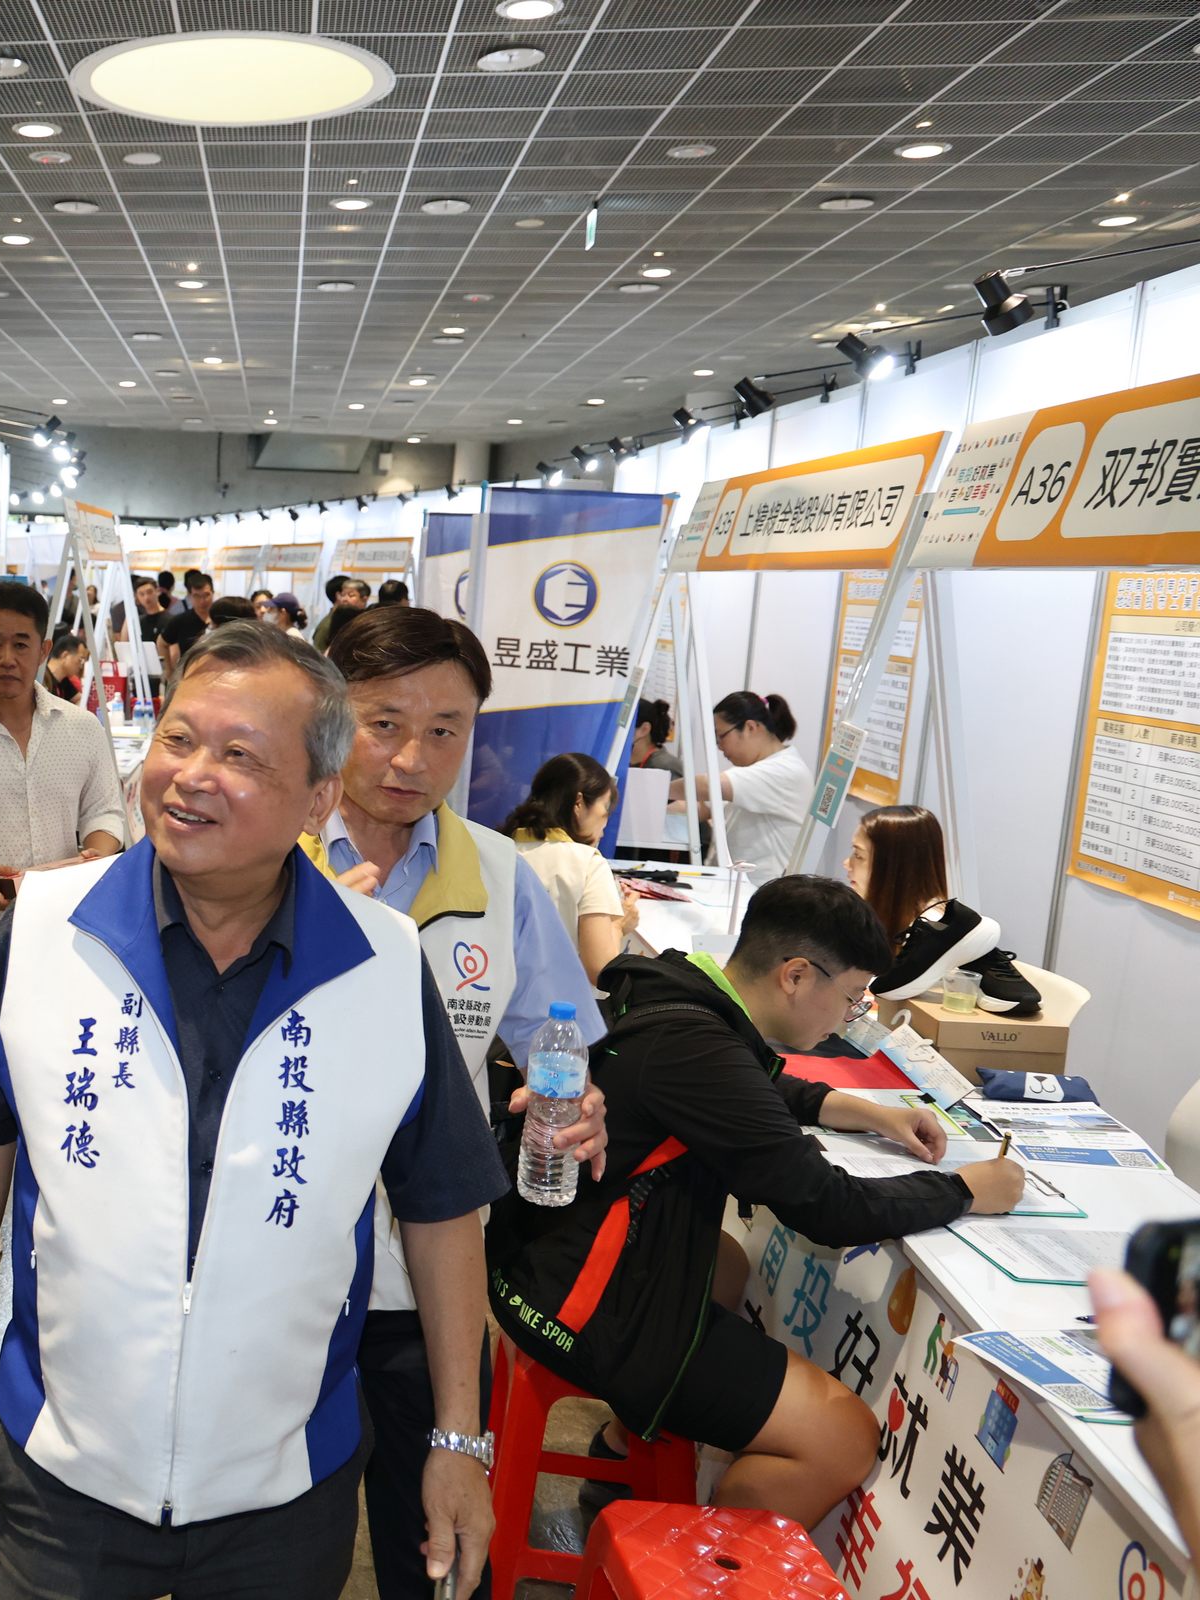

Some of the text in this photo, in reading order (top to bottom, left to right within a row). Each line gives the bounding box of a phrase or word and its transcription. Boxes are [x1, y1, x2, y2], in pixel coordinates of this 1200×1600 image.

[1011, 461, 1071, 507] A36
[492, 637, 631, 678] 昱盛工業
[111, 992, 143, 1089] 副縣長
[981, 1031, 1017, 1042] VALLO
[60, 1017, 100, 1168] 王瑞德
[265, 1009, 314, 1228] 南投縣政府
[518, 1302, 544, 1329] NIKE
[542, 1321, 575, 1353] SPOR
